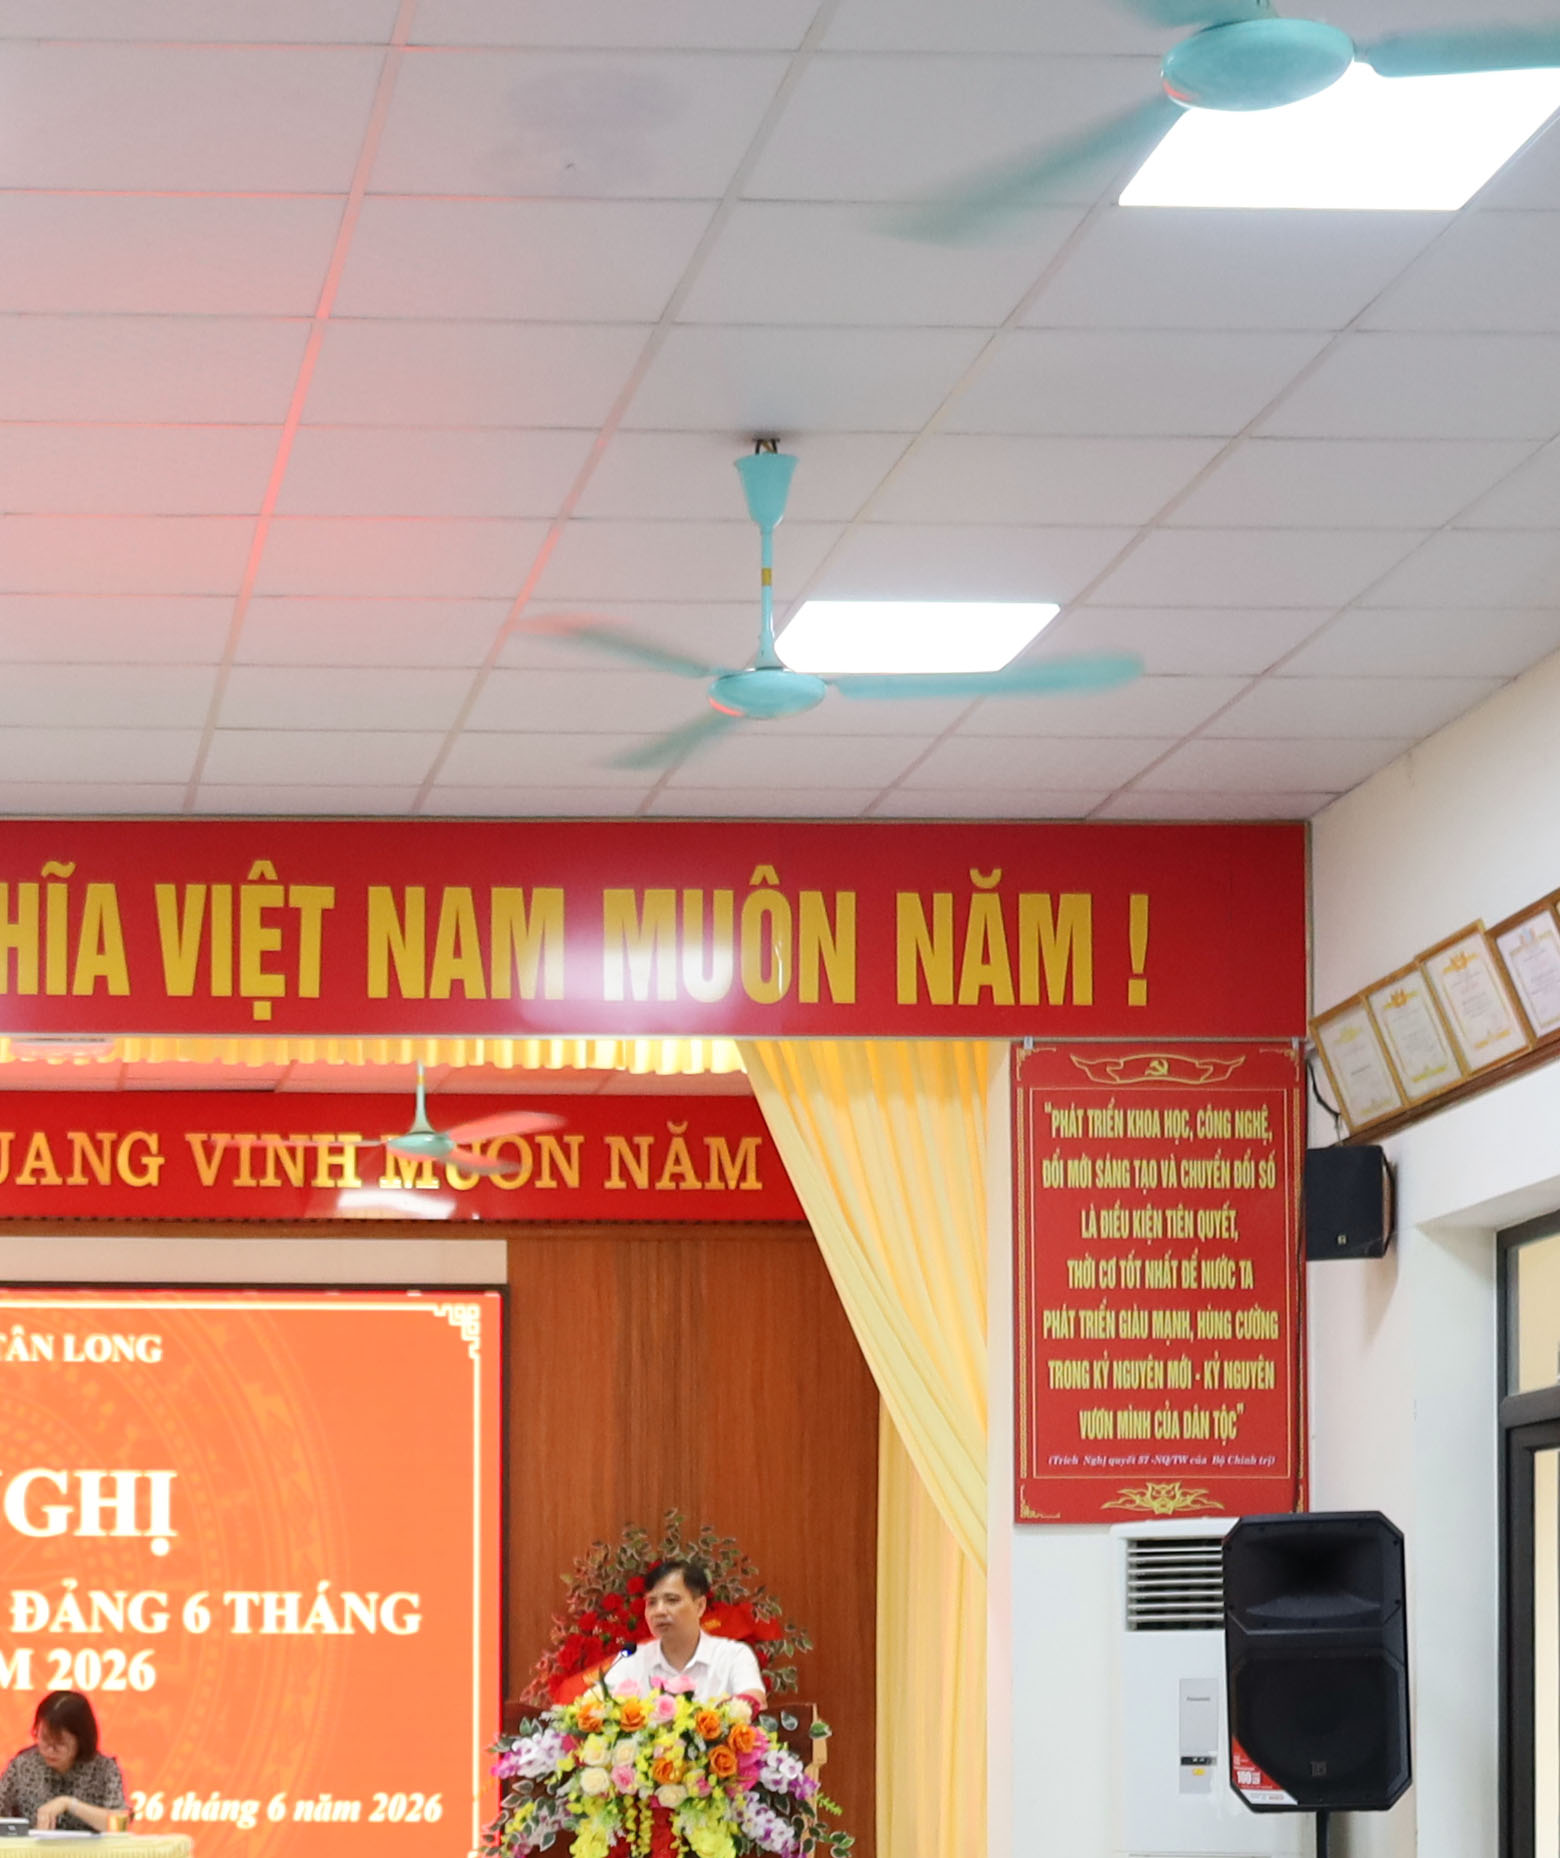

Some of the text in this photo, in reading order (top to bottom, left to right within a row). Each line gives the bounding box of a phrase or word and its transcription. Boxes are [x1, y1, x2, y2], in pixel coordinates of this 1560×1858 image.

[155, 859, 337, 1020] VIỆT
[367, 883, 565, 1004] NAM
[603, 862, 855, 1005] MUÔN
[894, 867, 1093, 1008] NĂM
[1127, 891, 1151, 1008] !
[1045, 1099, 1272, 1146] “PHÁT TRIỂN KHOA HỌC, CÔNG NGHỆ,
[184, 1132, 362, 1188] VINH
[604, 1120, 763, 1190] NĂM
[1042, 1150, 1275, 1195] ĐỔI MỚI SÁNG TẠO VÀ CHUYỂN ĐỔI SỐ
[1082, 1203, 1238, 1246] LÀ ĐIỀU KIỆN TIÊN QUYẾT,
[1067, 1250, 1253, 1288] THỜI CƠ TỐT NHẤT ĐỂ NƯỚC TA
[1043, 1300, 1278, 1346] PHÁT TRIỂN GIÀU MẠNH, HÙNG CƯỜNG
[64, 1334, 162, 1363] LONG
[1048, 1360, 1090, 1389] TRONG
[1093, 1354, 1109, 1388] KỶ
[1113, 1356, 1164, 1389] NGUYÊN
[1167, 1357, 1192, 1389] MỚI
[1204, 1352, 1220, 1388] KỶ
[1224, 1356, 1274, 1389] NGUYÊN
[1080, 1403, 1244, 1446] VƯƠN MÌNH CỦA DÂN TỘC”
[11, 1579, 169, 1633] ĐẢNG
[183, 1592, 210, 1633] 6
[224, 1580, 421, 1634] THÁNG
[48, 1648, 156, 1691] 2026
[171, 1792, 260, 1829] tháng
[267, 1793, 286, 1821] 6
[293, 1794, 361, 1821] năm
[369, 1793, 442, 1822] 2026
